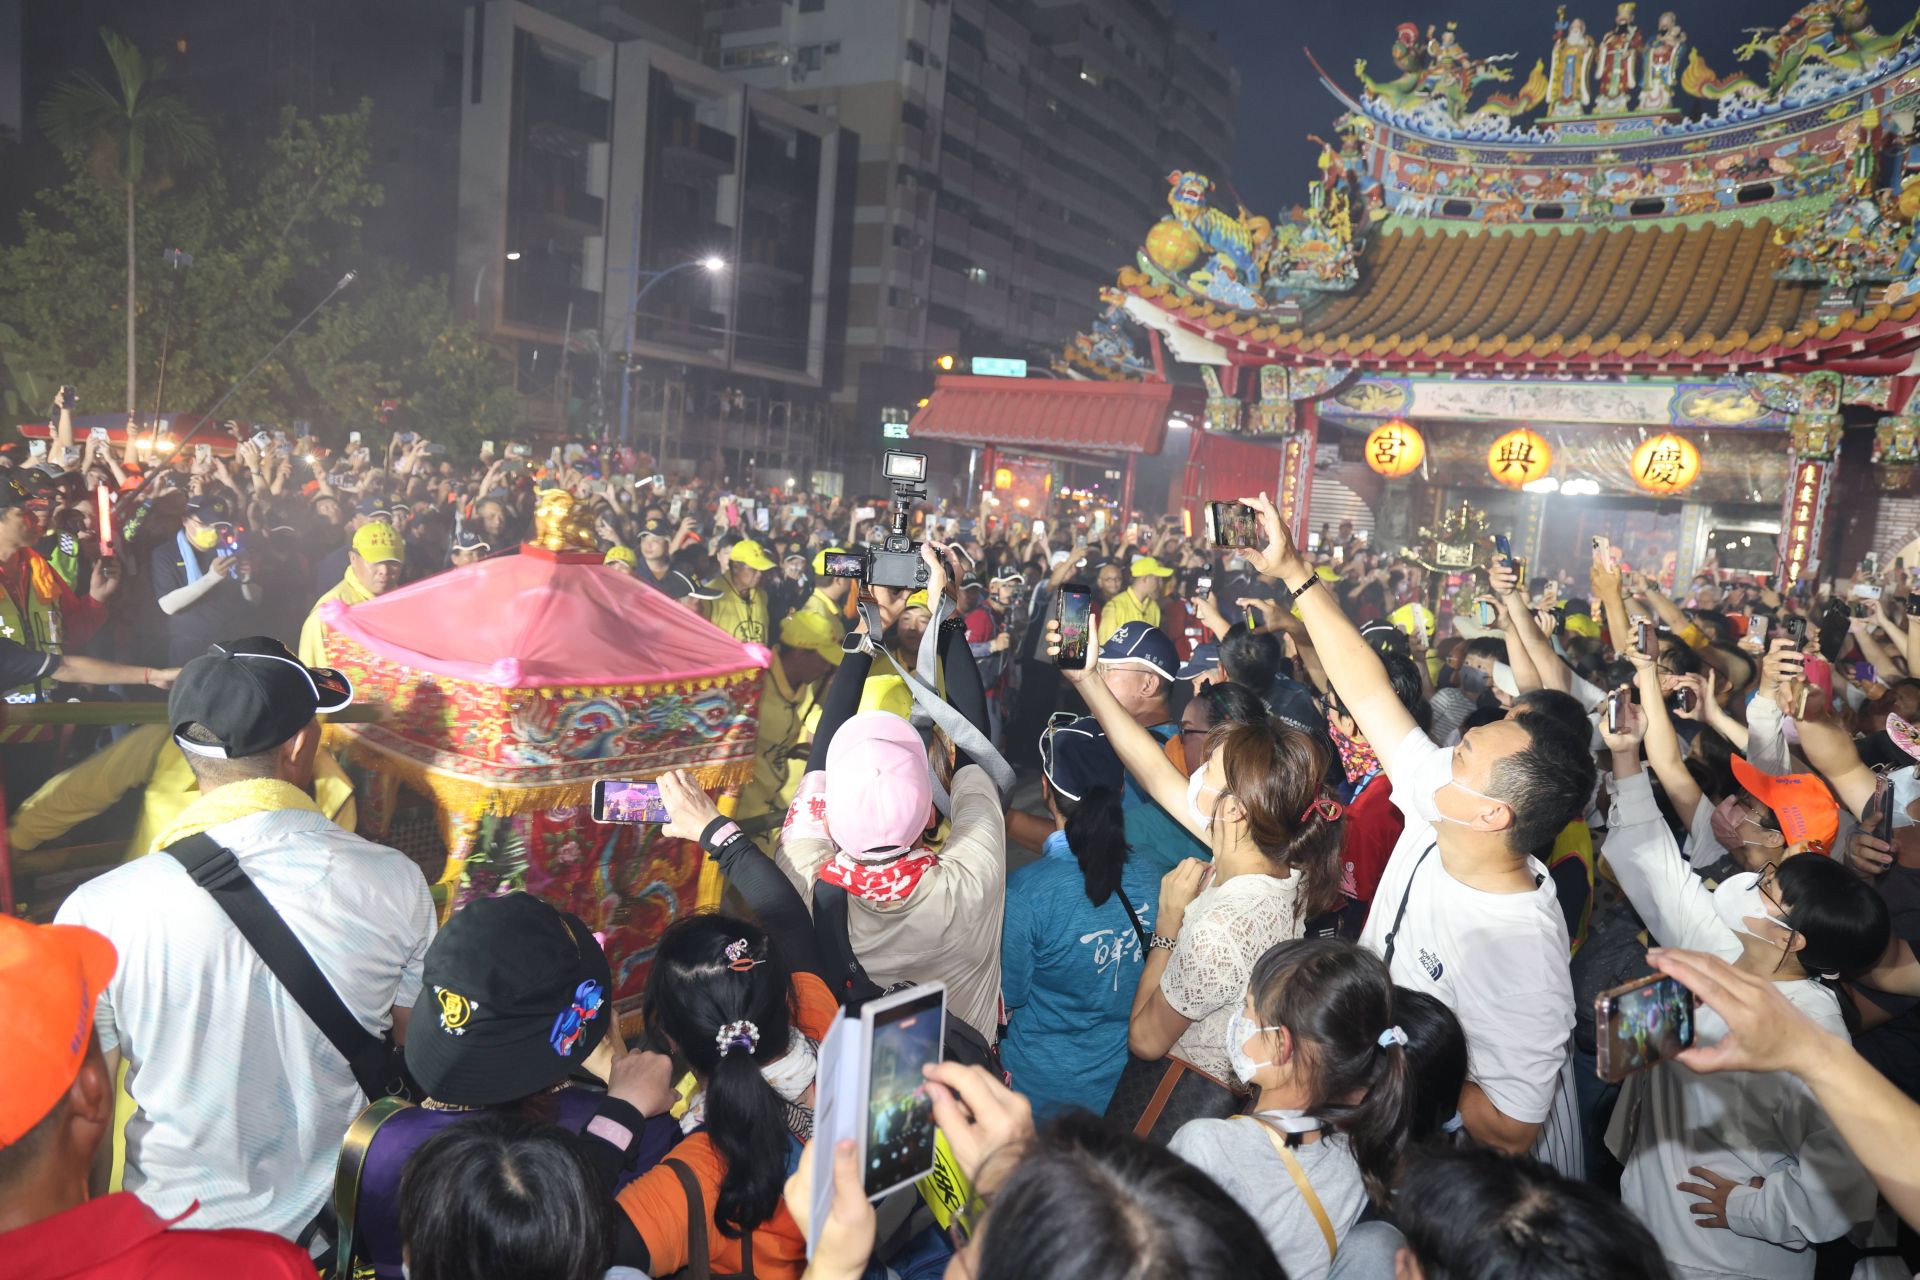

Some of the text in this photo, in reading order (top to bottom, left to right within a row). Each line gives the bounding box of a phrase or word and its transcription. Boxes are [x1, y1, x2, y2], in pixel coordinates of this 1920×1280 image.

[1373, 432, 1405, 465] 宮
[1496, 441, 1536, 473] 興
[1642, 446, 1685, 486] 慶
[1418, 956, 1433, 972] FACE
[1419, 947, 1438, 969] NORTH
[1430, 952, 1440, 966] THE
